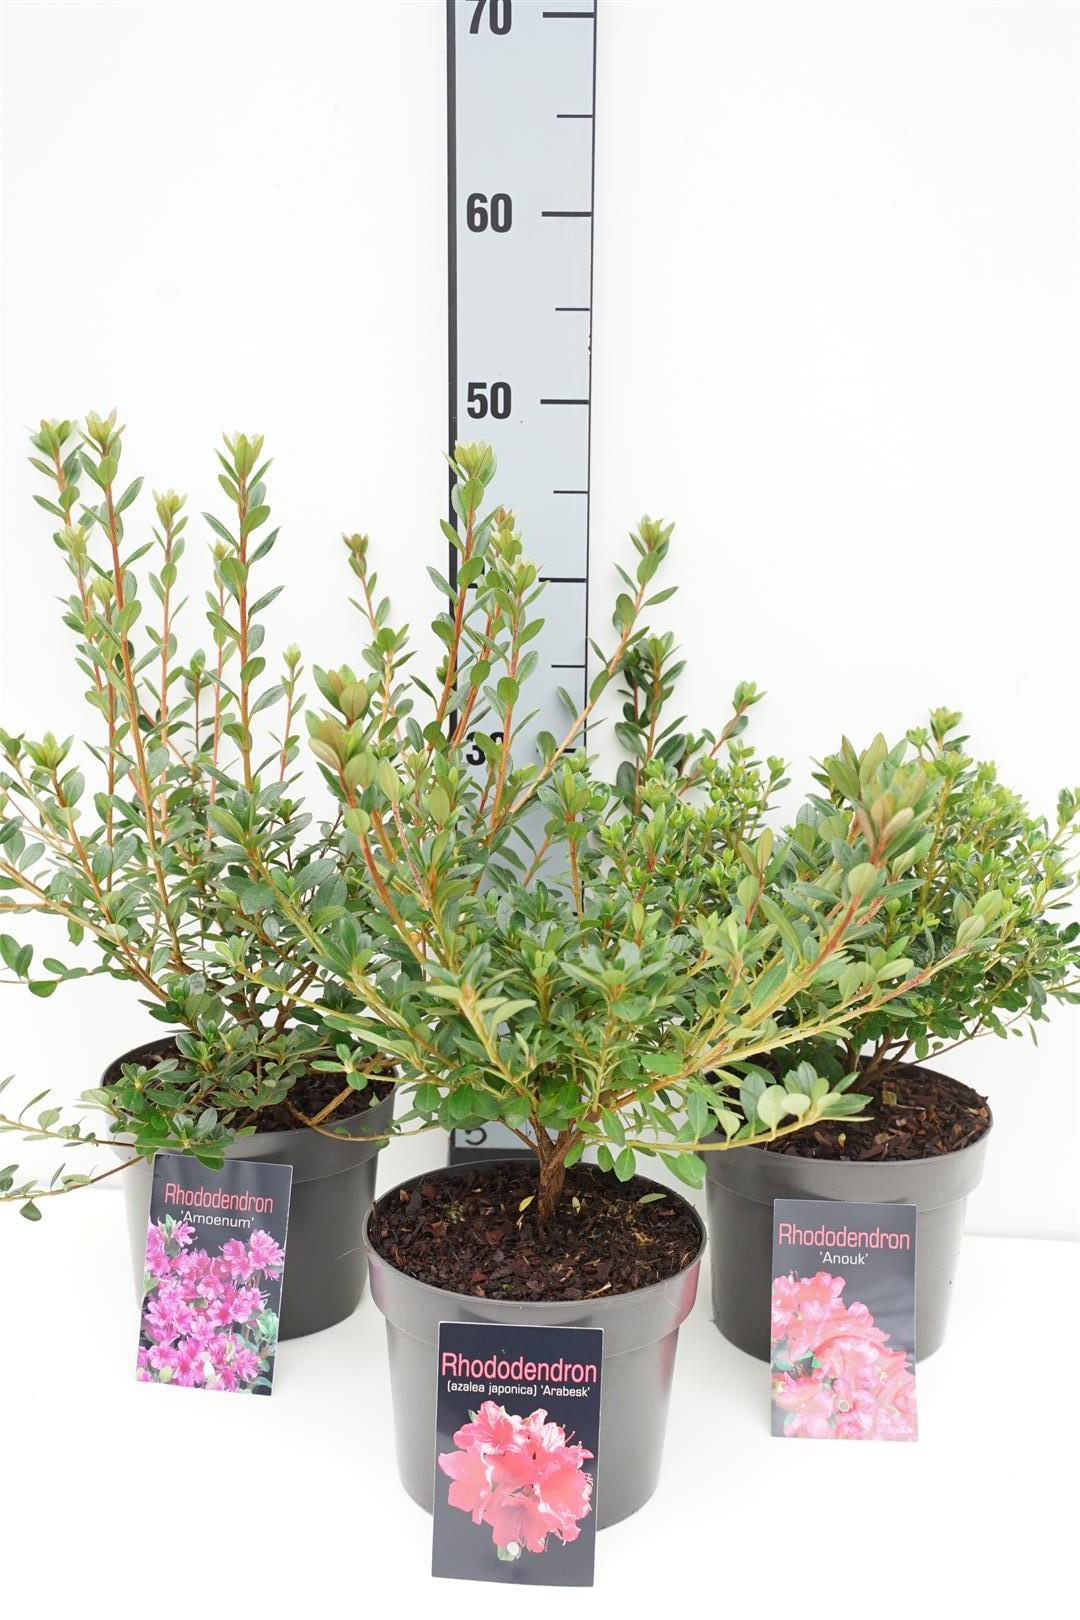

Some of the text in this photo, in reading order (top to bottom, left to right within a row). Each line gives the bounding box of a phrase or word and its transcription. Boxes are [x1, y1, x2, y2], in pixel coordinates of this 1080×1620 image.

[466, 0, 513, 35] 70
[466, 193, 513, 233] 60
[466, 382, 513, 420] 50
[164, 1183, 274, 1214] Rhododendron
[180, 1210, 255, 1229] 'Amoenum'
[778, 1223, 911, 1250] Rhododendron
[819, 1251, 869, 1265] 'Anouk'
[441, 1352, 597, 1383] Rhododendron
[447, 1380, 591, 1398] (azalea japonica) 'Arabesk'
